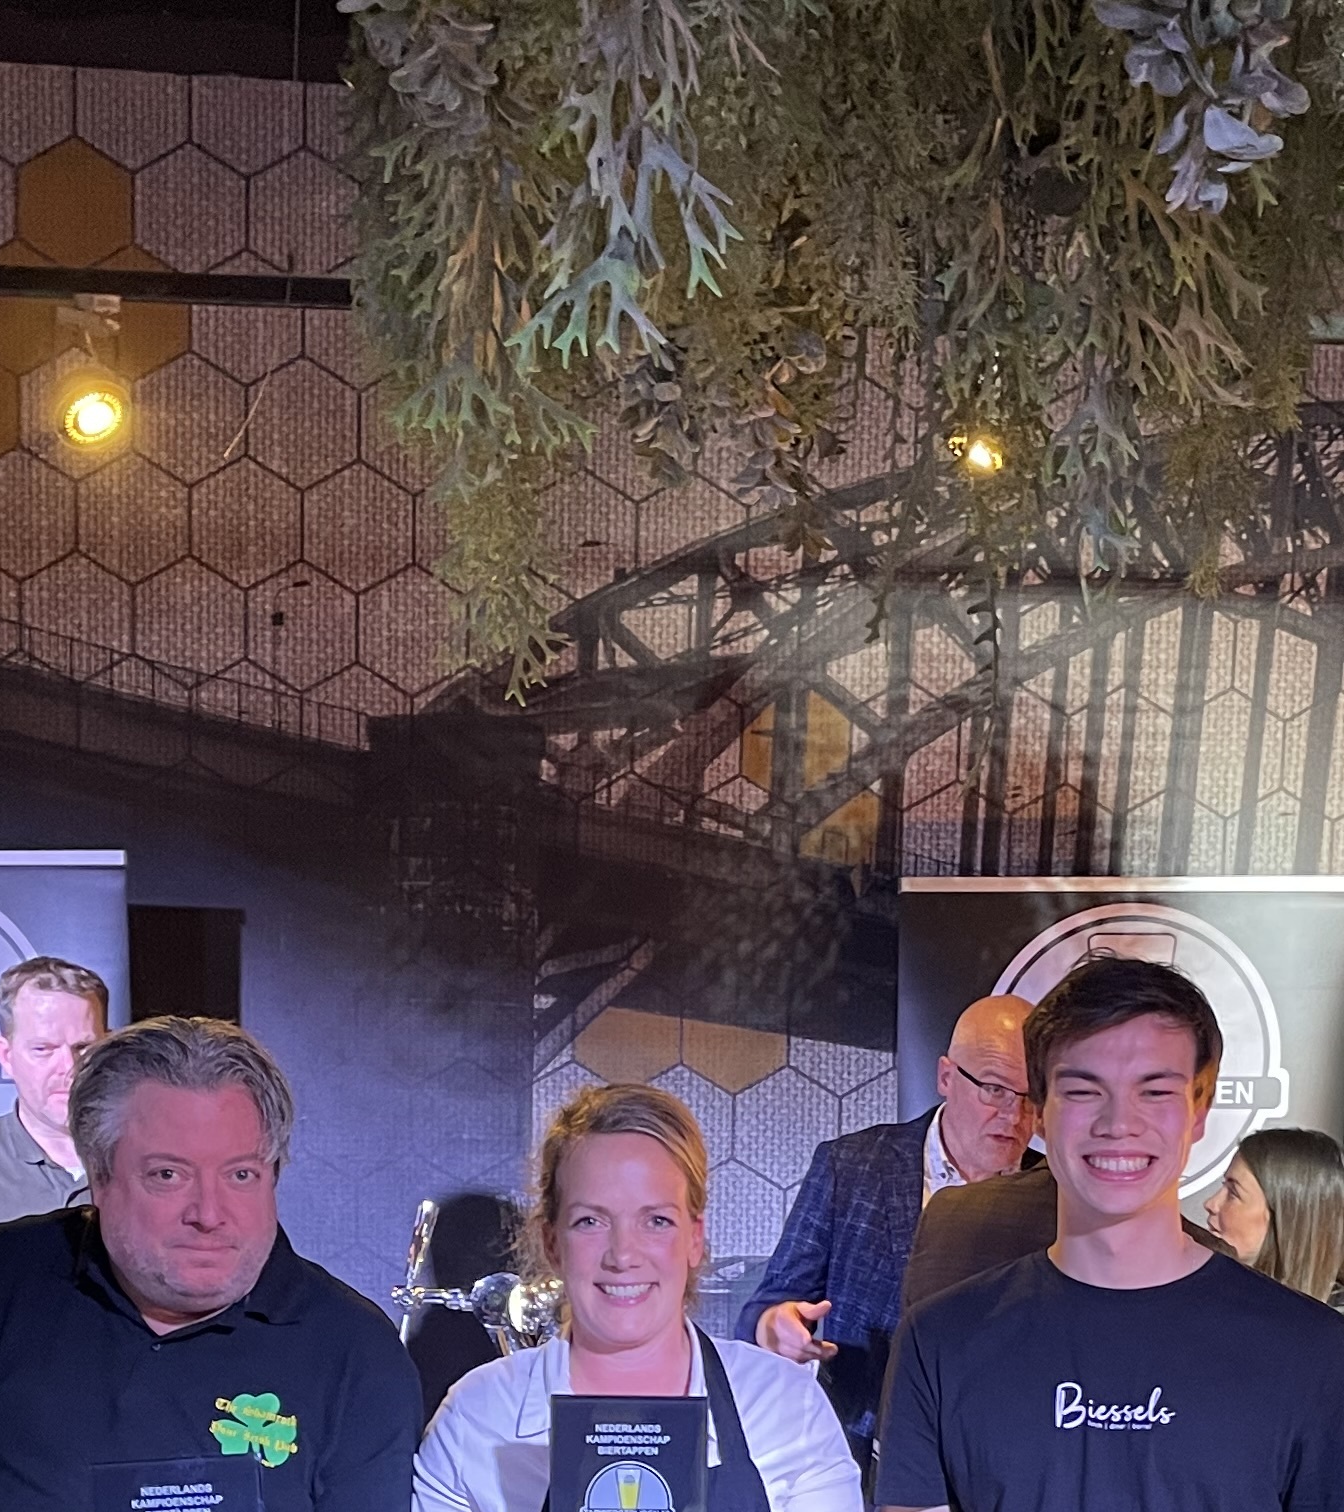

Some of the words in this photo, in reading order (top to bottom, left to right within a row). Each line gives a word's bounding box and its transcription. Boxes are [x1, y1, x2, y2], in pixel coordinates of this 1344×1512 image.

[1056, 1382, 1176, 1429] Biessels
[595, 1424, 661, 1433] NEDERLANDS
[586, 1435, 671, 1445] KAMPIOENSCHAP
[598, 1446, 658, 1455] BIERTAPPEN
[140, 1484, 212, 1496] NEDERLANDS
[131, 1495, 223, 1509] KAMPIOENSCHAP
